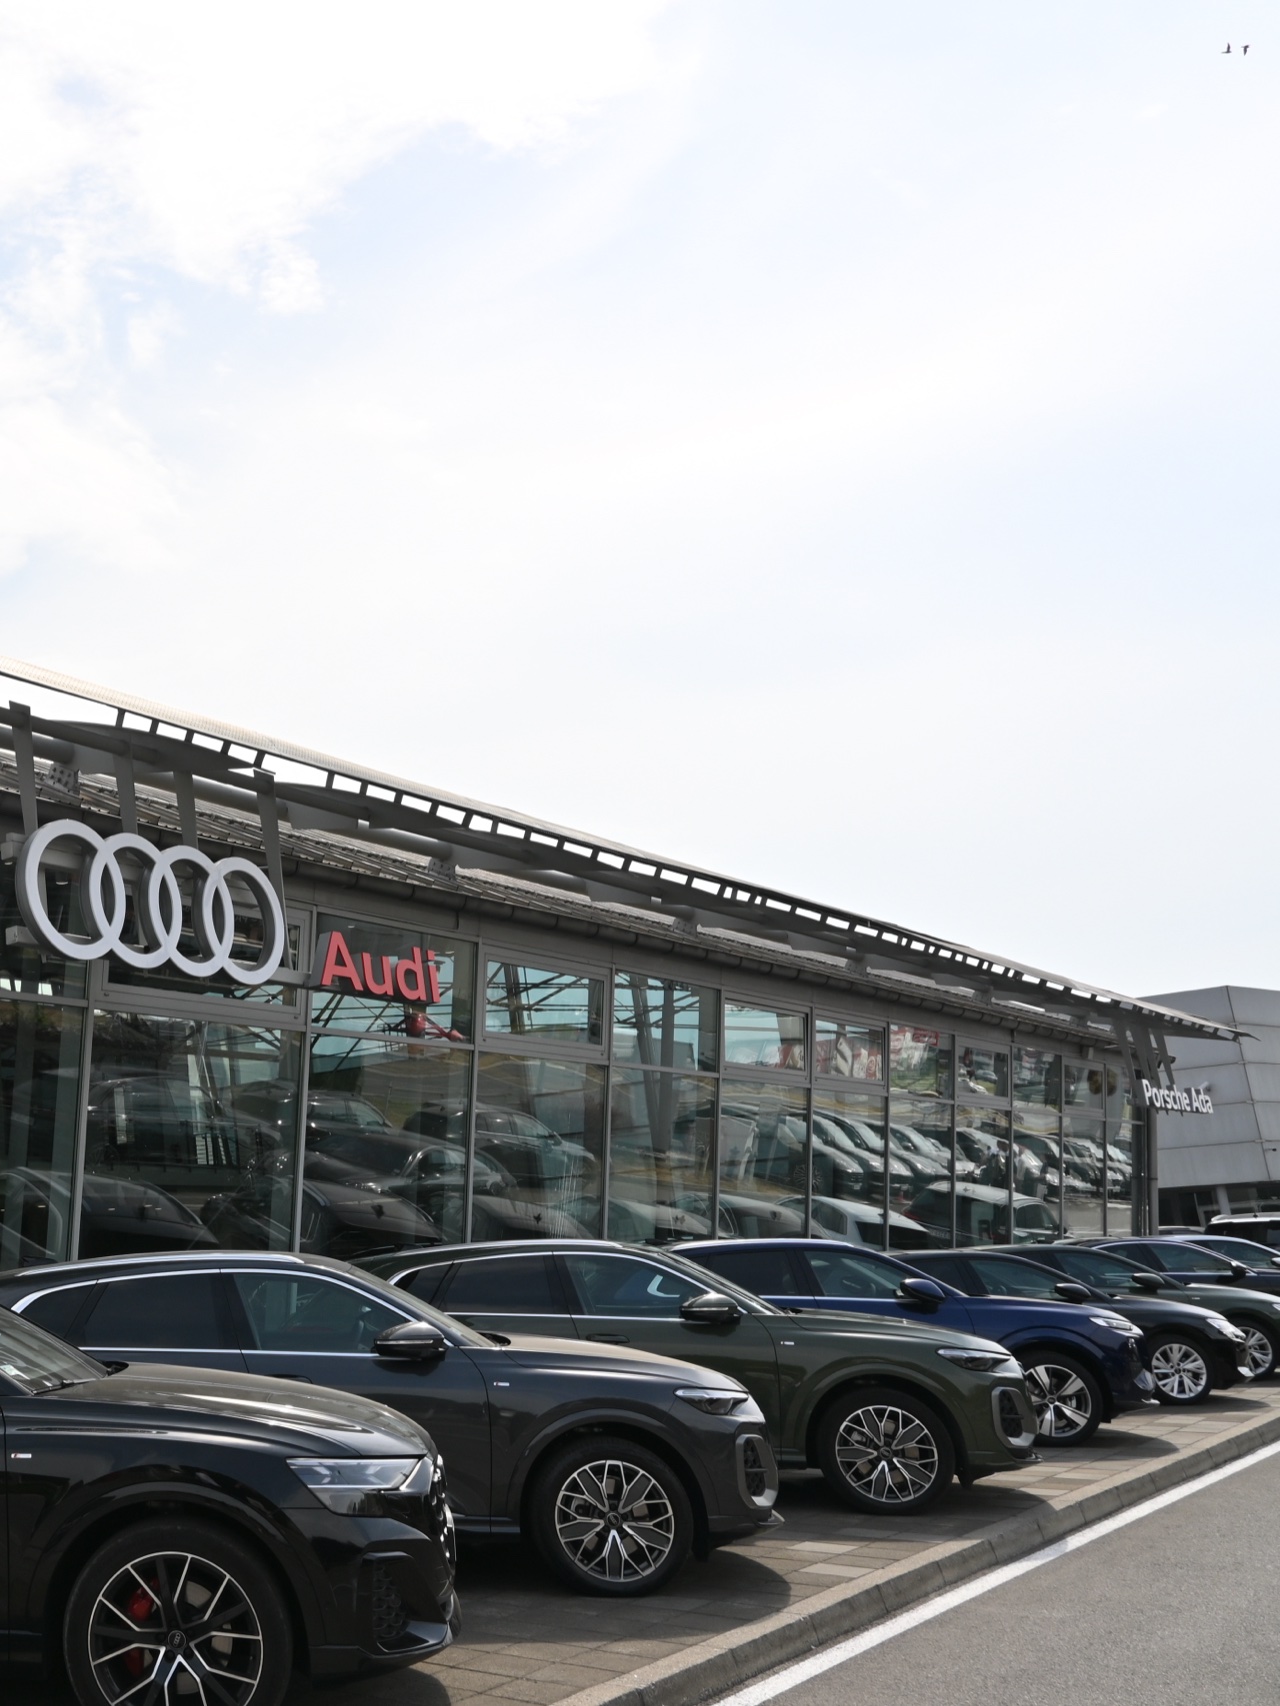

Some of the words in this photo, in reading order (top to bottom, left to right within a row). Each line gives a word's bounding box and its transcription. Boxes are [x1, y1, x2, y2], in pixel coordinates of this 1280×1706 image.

[321, 930, 441, 1003] Audi
[1141, 1079, 1190, 1112] Porsche
[1191, 1087, 1214, 1114] Ada
